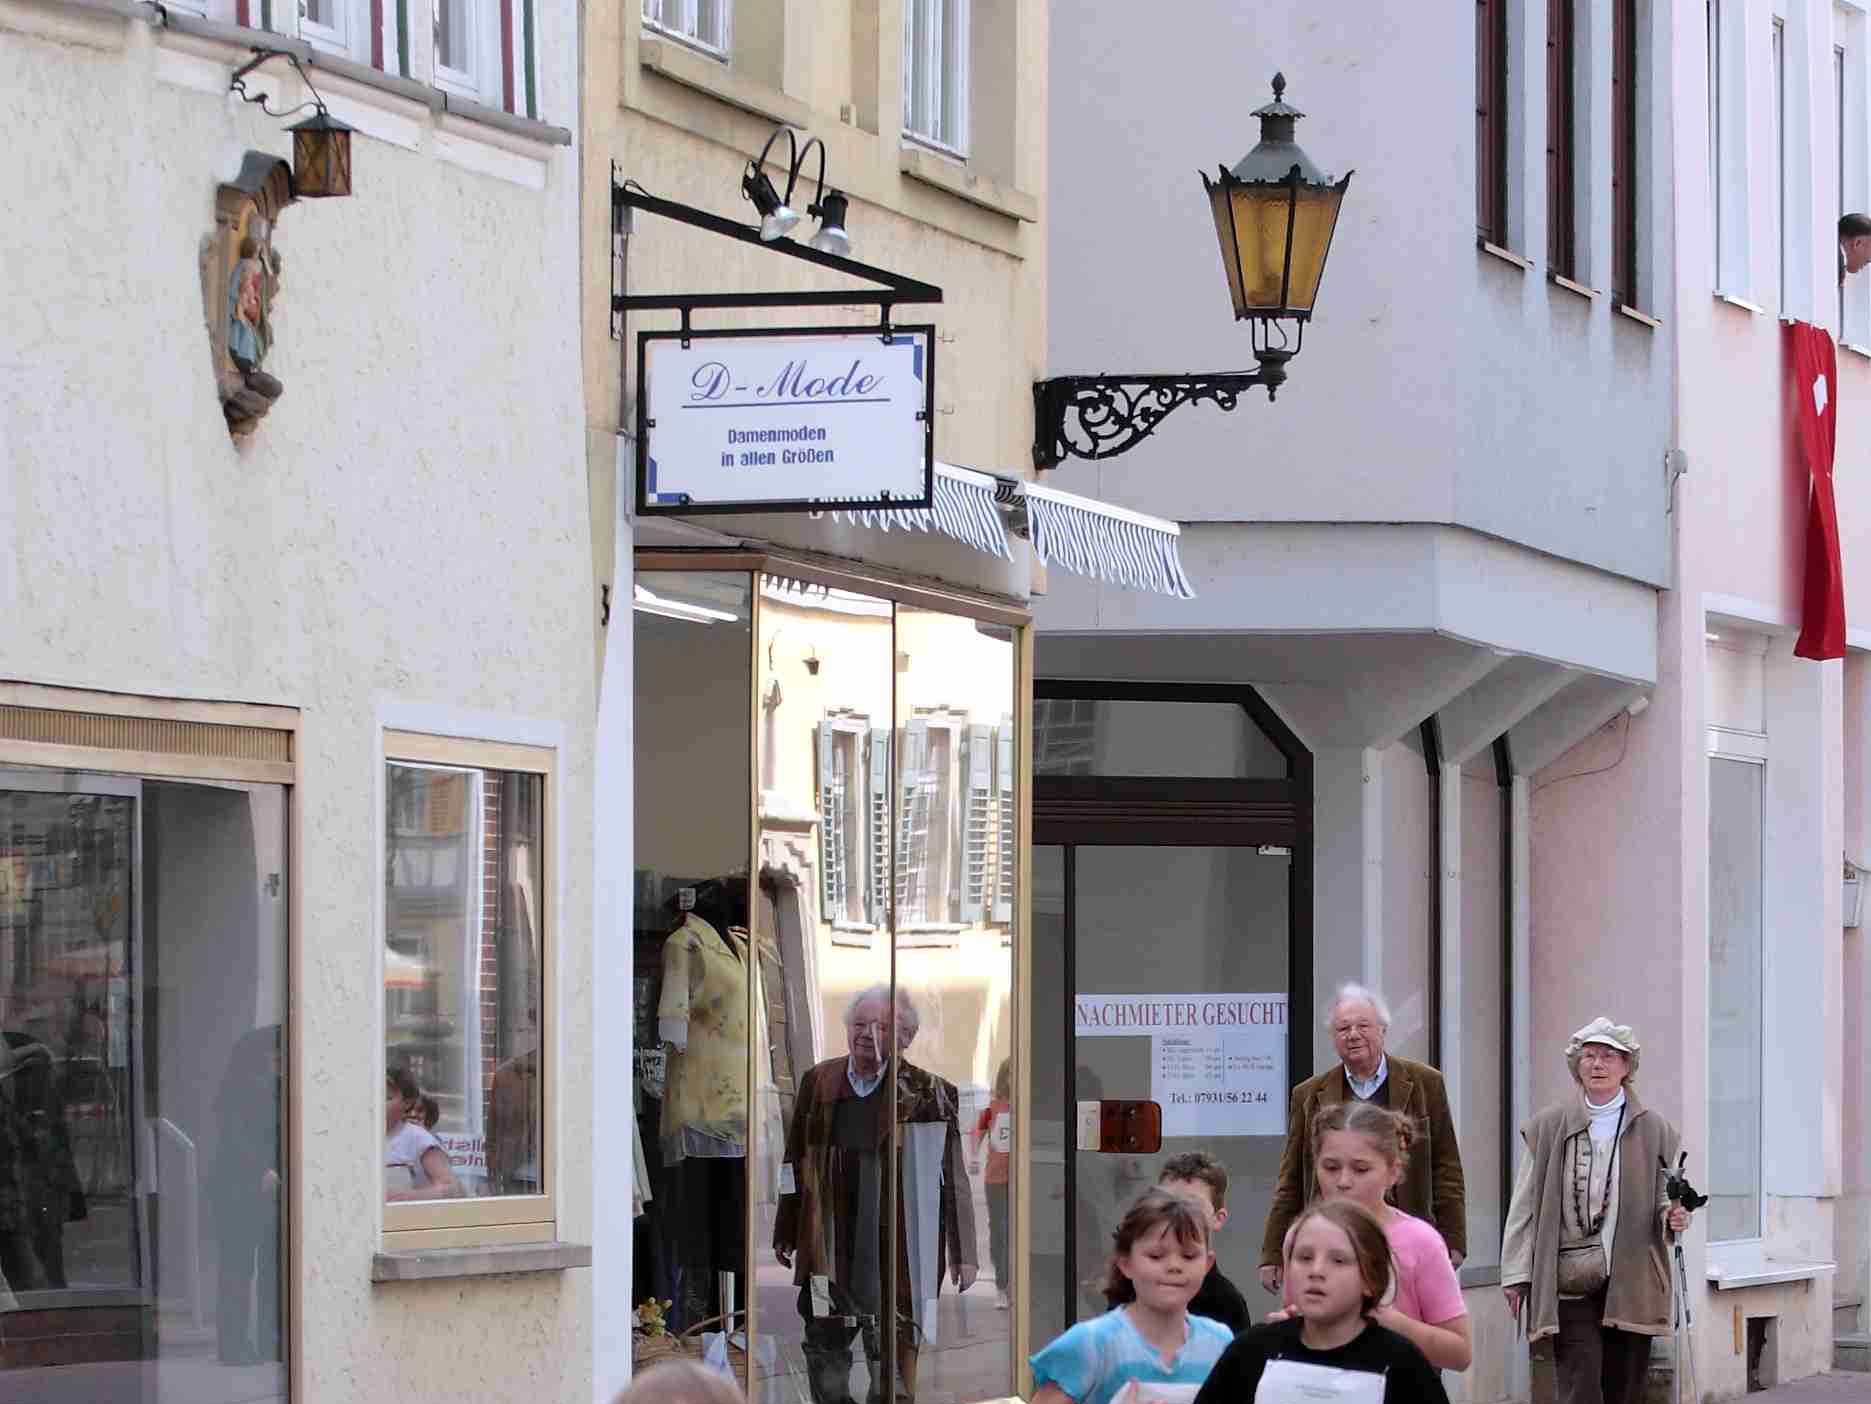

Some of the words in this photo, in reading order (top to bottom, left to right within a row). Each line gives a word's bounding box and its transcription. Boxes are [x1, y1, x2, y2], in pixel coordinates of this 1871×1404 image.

[691, 359, 886, 401] D-Mode
[728, 425, 826, 445] Damenmoden
[721, 451, 734, 467] in
[740, 449, 776, 467] allen
[782, 448, 834, 465] Größen
[1077, 1002, 1198, 1026] NACHMIETER
[1202, 1001, 1288, 1025] GESUCHT
[1169, 1091, 1191, 1104] Tel.:
[1241, 1091, 1253, 1104] 22
